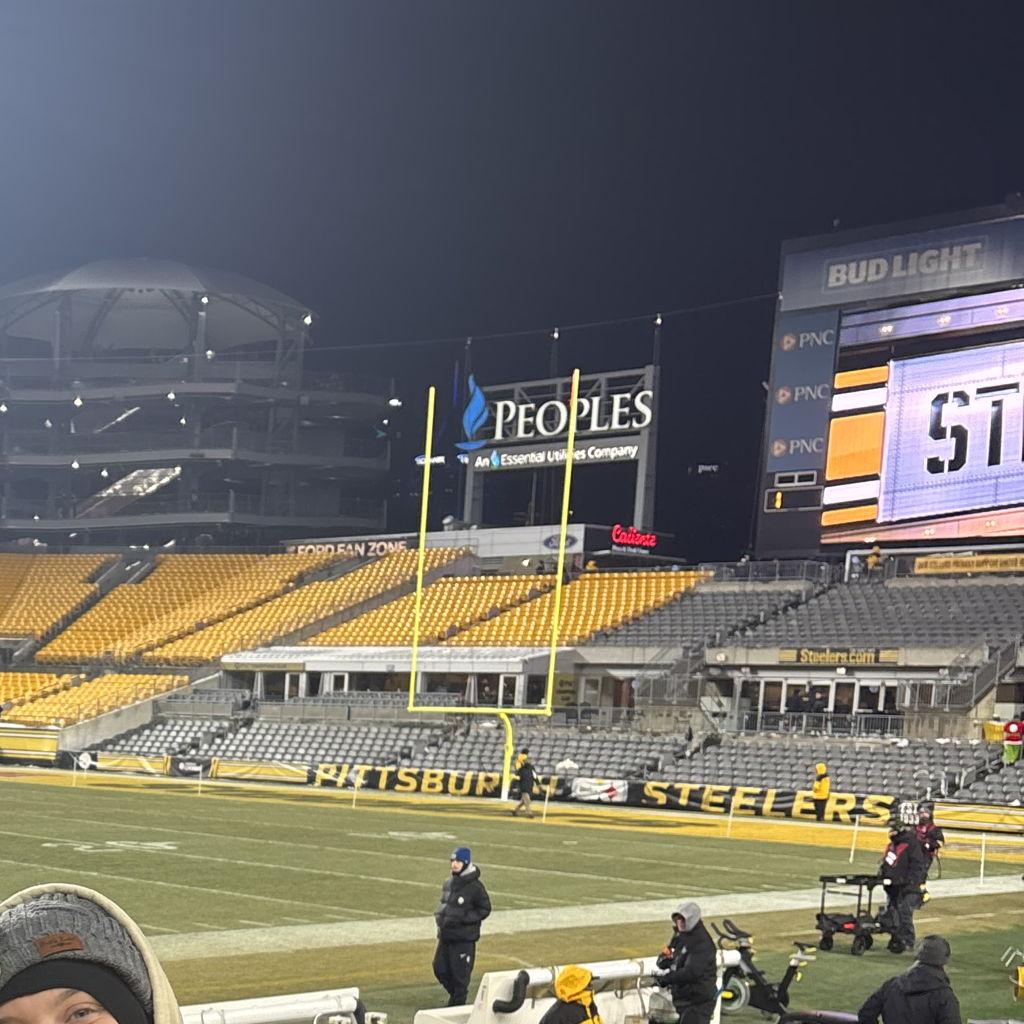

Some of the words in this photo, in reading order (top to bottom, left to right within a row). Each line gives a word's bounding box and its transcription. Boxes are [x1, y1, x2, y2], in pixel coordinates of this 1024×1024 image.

[827, 258, 889, 288] BUD
[891, 243, 982, 278] LIGHT
[799, 329, 834, 348] PNC
[794, 384, 830, 402] PNC
[493, 390, 654, 441] PEOPLES
[927, 382, 1024, 474] ST
[789, 437, 825, 454] PNC
[474, 456, 490, 468] An
[500, 450, 546, 467] Essential
[587, 445, 638, 460] Company
[297, 544, 334, 557] FORD
[337, 542, 365, 557] FAN
[367, 540, 407, 557] ZONE
[800, 648, 876, 664] Steelers.com
[315, 763, 558, 798] PITTSBURH
[644, 781, 895, 826] STEELERS
